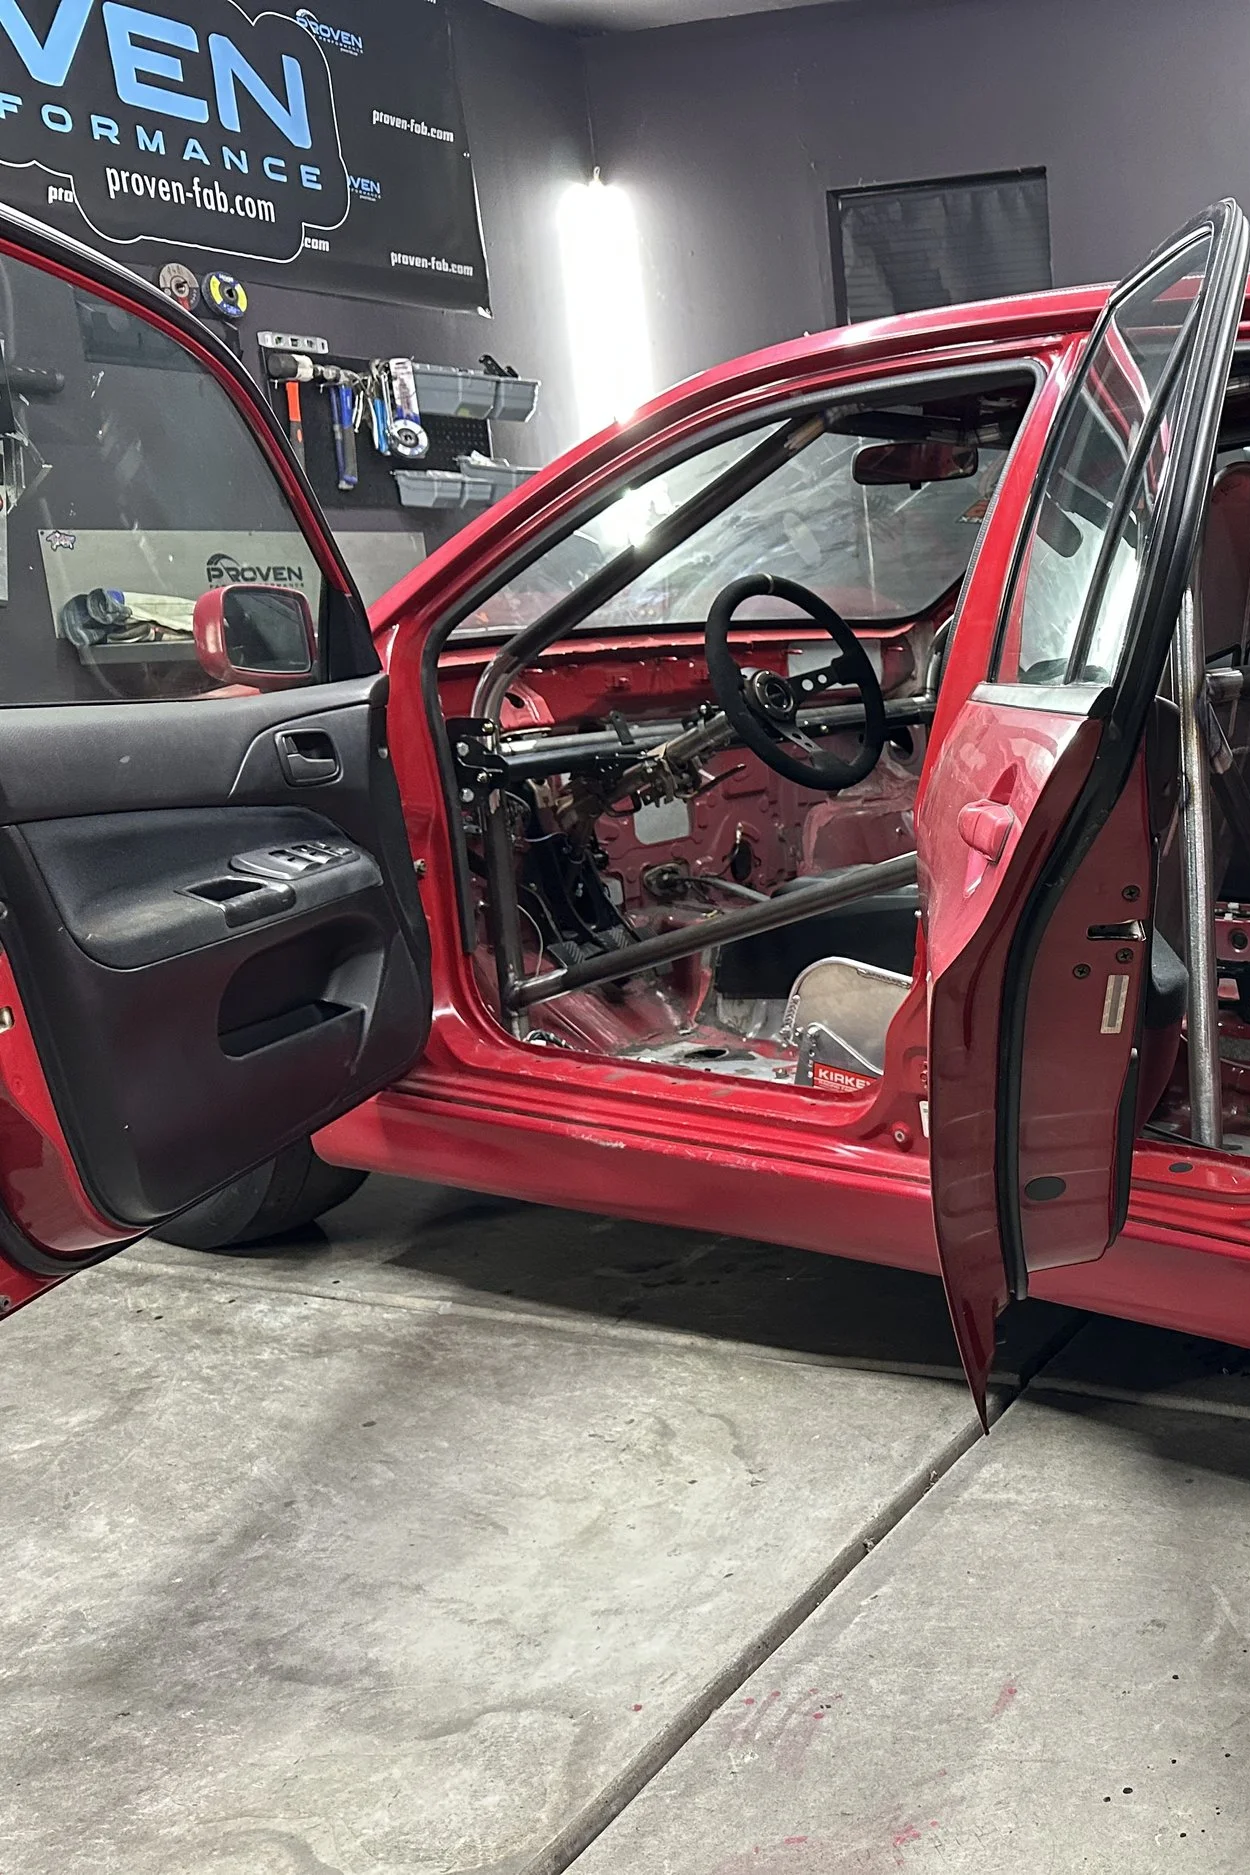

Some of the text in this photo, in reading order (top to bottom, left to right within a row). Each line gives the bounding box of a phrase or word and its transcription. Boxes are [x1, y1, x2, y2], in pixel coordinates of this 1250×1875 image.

[295, 17, 363, 49] PROVEN
[0, 0, 313, 149] VEN
[371, 109, 455, 144] proven-fab.com
[105, 166, 277, 224] proven-fab.com
[348, 175, 381, 195] VEN
[389, 251, 474, 277] proven-fab.com
[206, 566, 304, 583] PROVEN
